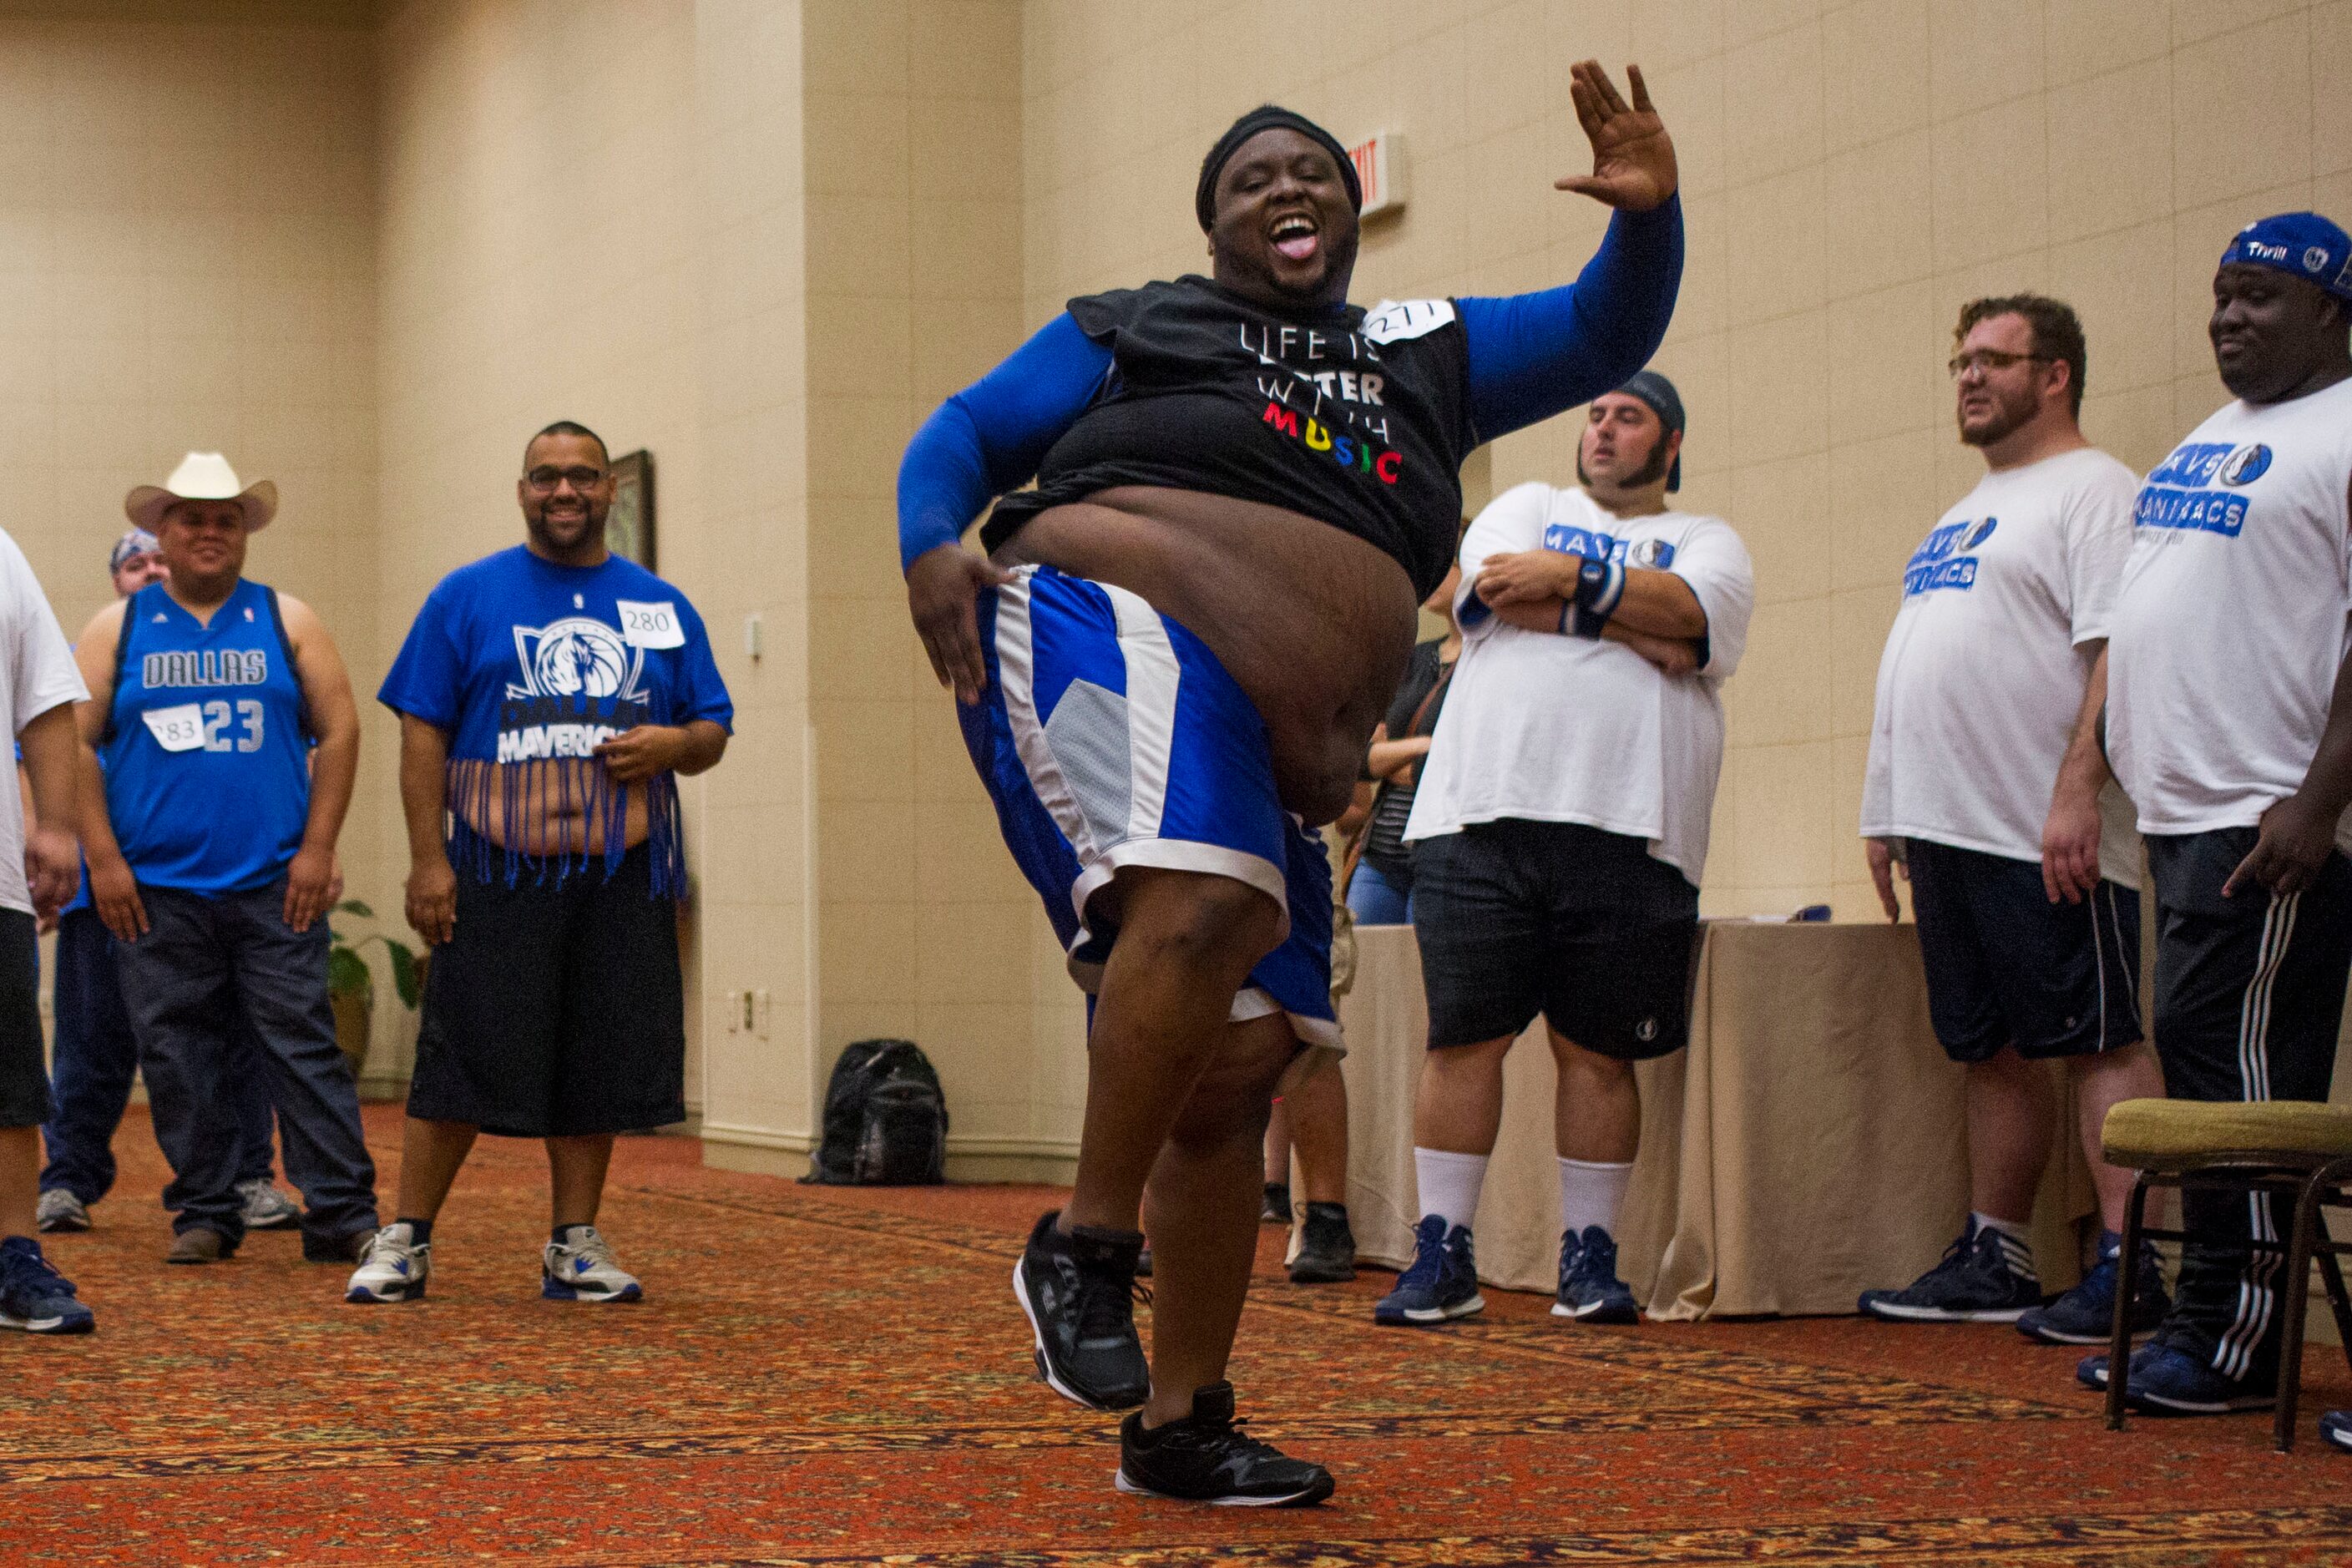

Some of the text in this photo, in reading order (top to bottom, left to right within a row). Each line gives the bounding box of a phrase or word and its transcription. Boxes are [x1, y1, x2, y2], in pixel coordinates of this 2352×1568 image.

[2247, 241, 2288, 260] Thrill
[1241, 323, 1381, 362] LIFE IS
[1262, 402, 1403, 484] MUSIC
[625, 610, 670, 632] 280
[143, 649, 267, 690] DALLAS
[203, 699, 265, 752] 23
